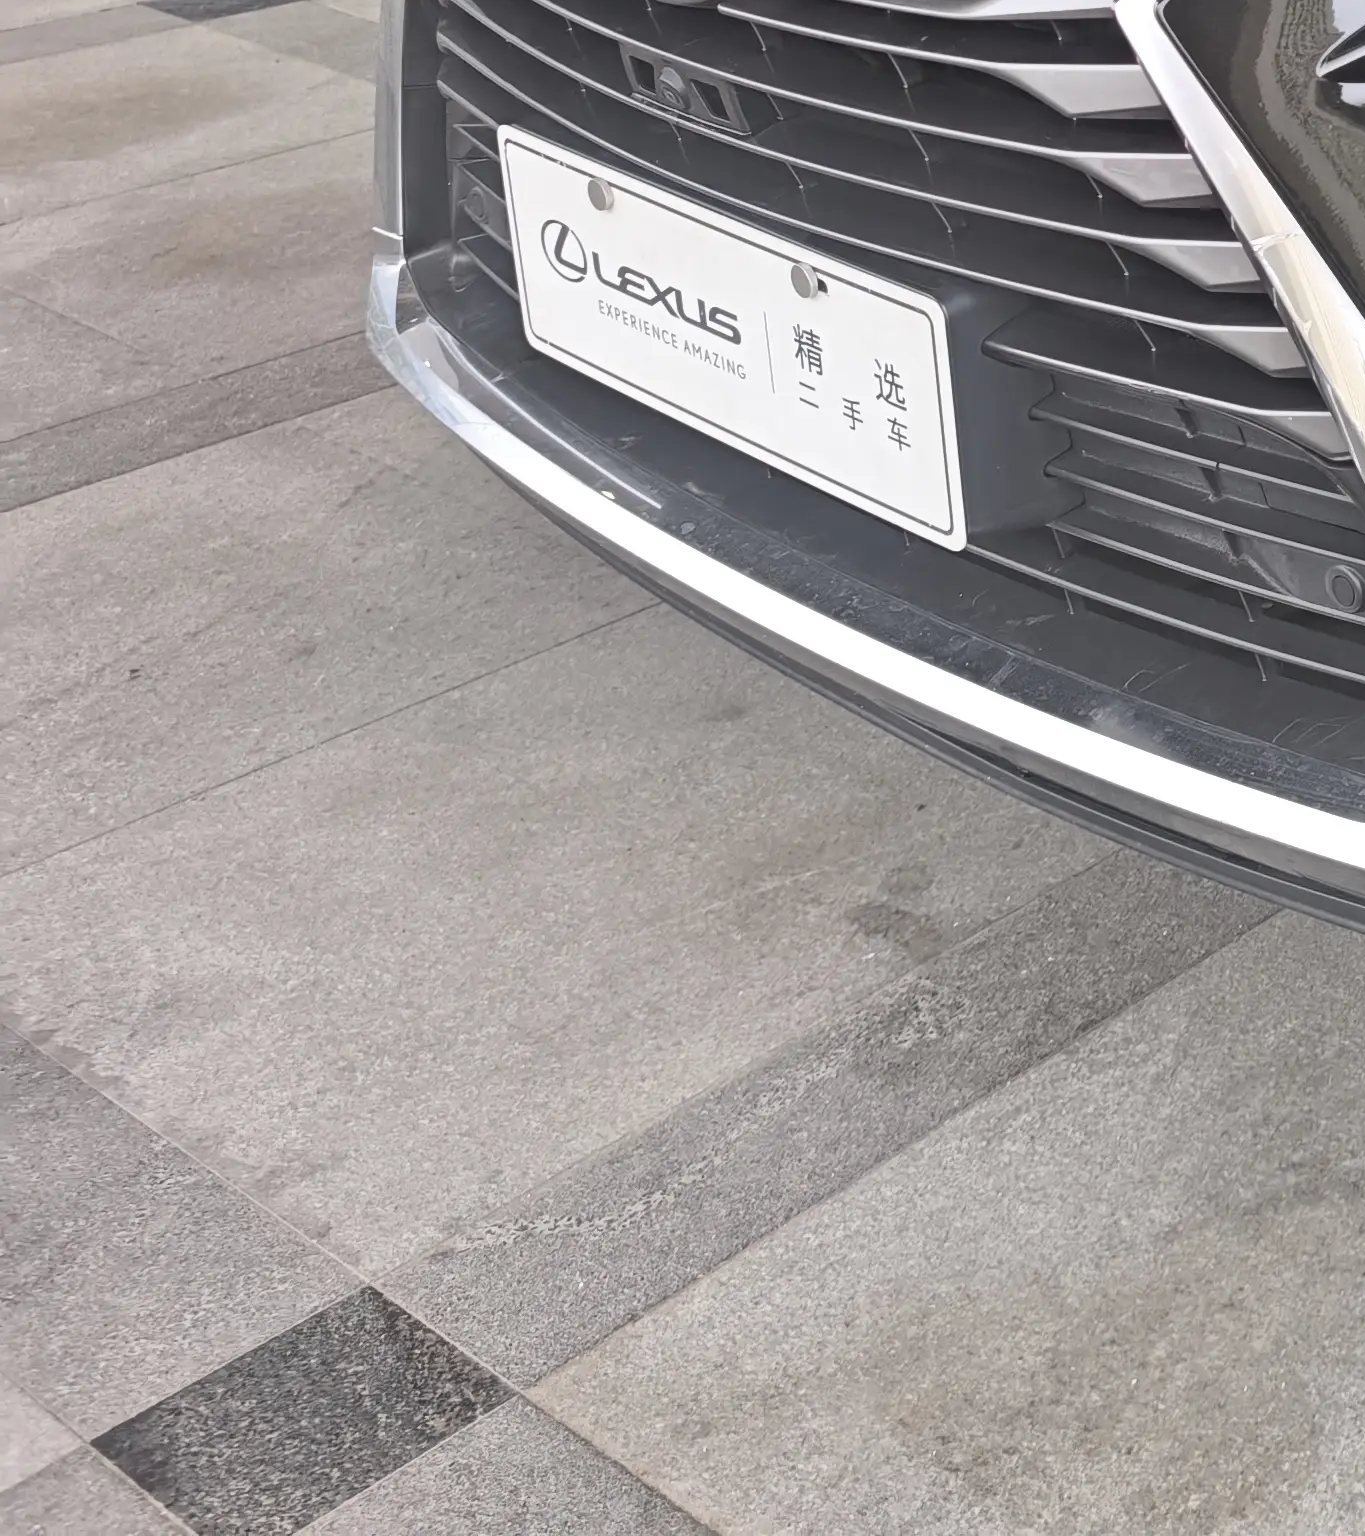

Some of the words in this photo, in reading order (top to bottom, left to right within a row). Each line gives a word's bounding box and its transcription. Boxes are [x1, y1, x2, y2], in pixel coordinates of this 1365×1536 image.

[592, 251, 743, 346] LEXUS
[597, 299, 679, 350] EXPERIENCE
[683, 339, 748, 381] AMAZING
[792, 323, 908, 412] 精选
[798, 380, 912, 452] 二手车
